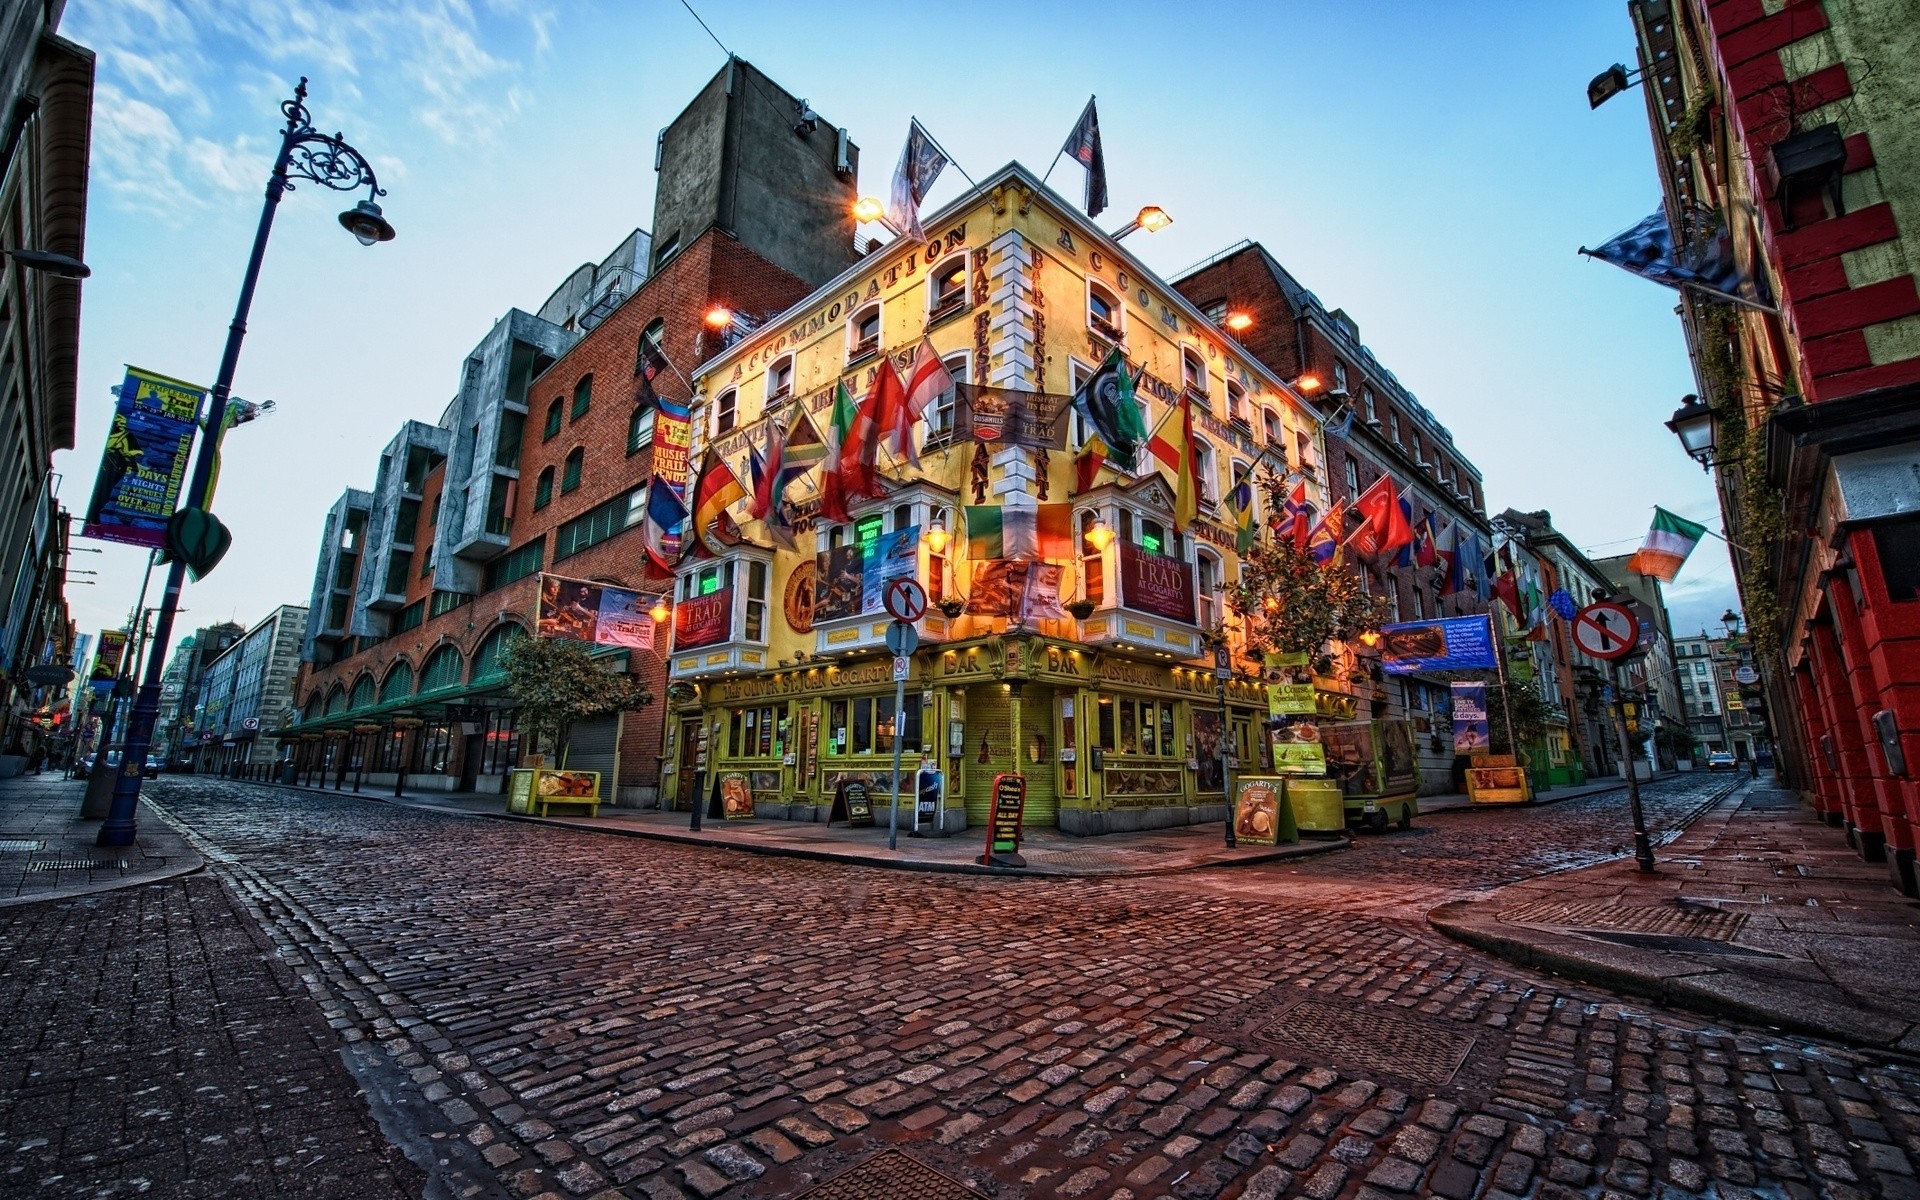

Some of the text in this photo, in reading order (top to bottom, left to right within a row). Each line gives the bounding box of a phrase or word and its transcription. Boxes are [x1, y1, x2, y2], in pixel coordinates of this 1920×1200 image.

[973, 248, 990, 309] BAR
[1031, 247, 1045, 309] BAR
[731, 221, 968, 383] ACCOMMODATION
[1057, 228, 1299, 424] ACCOMMODATION
[811, 374, 858, 415] IRIH
[1026, 394, 1046, 403] IRISH
[168, 395, 195, 409] Trad
[1026, 402, 1057, 413] ITS BEST
[163, 411, 176, 419] JAN
[177, 415, 191, 423] 2012
[167, 404, 194, 418] Fest
[973, 415, 1004, 425] BUSHMILLS
[672, 425, 689, 435] Trad
[1024, 426, 1055, 437] TRAD
[655, 446, 686, 461] MUSIC
[653, 456, 686, 472] TRAIL
[126, 466, 168, 483] 5 DAYS
[131, 478, 166, 492] NIGHTS
[132, 486, 164, 498] VENUES
[118, 494, 161, 509] OVER 200
[1136, 549, 1181, 572] TEMPLE BAR
[1136, 558, 1183, 590] TRAD
[1138, 579, 1184, 600] AT GOGARTY'S
[687, 594, 722, 609] TEMPLE BAR
[686, 601, 722, 625] TRAD
[617, 623, 651, 636] TradFest
[685, 624, 693, 633] AT
[944, 652, 981, 675] BAR
[1048, 649, 1079, 675] BAR
[724, 682, 741, 699] THE
[744, 679, 778, 697] OLIVER
[799, 673, 825, 692] JOHN
[831, 664, 892, 686] GOGARTY
[1101, 662, 1161, 688] RESTAURANT
[1172, 671, 1191, 691] THE
[1194, 675, 1227, 695] OLIVR
[1276, 687, 1282, 695] 4
[1284, 685, 1308, 694] Course
[1273, 694, 1296, 703] Special
[1460, 712, 1480, 720] days.
[999, 784, 1021, 793] O'Shea's
[1240, 780, 1279, 793] GOGARTY'S
[919, 801, 935, 812] ATM
